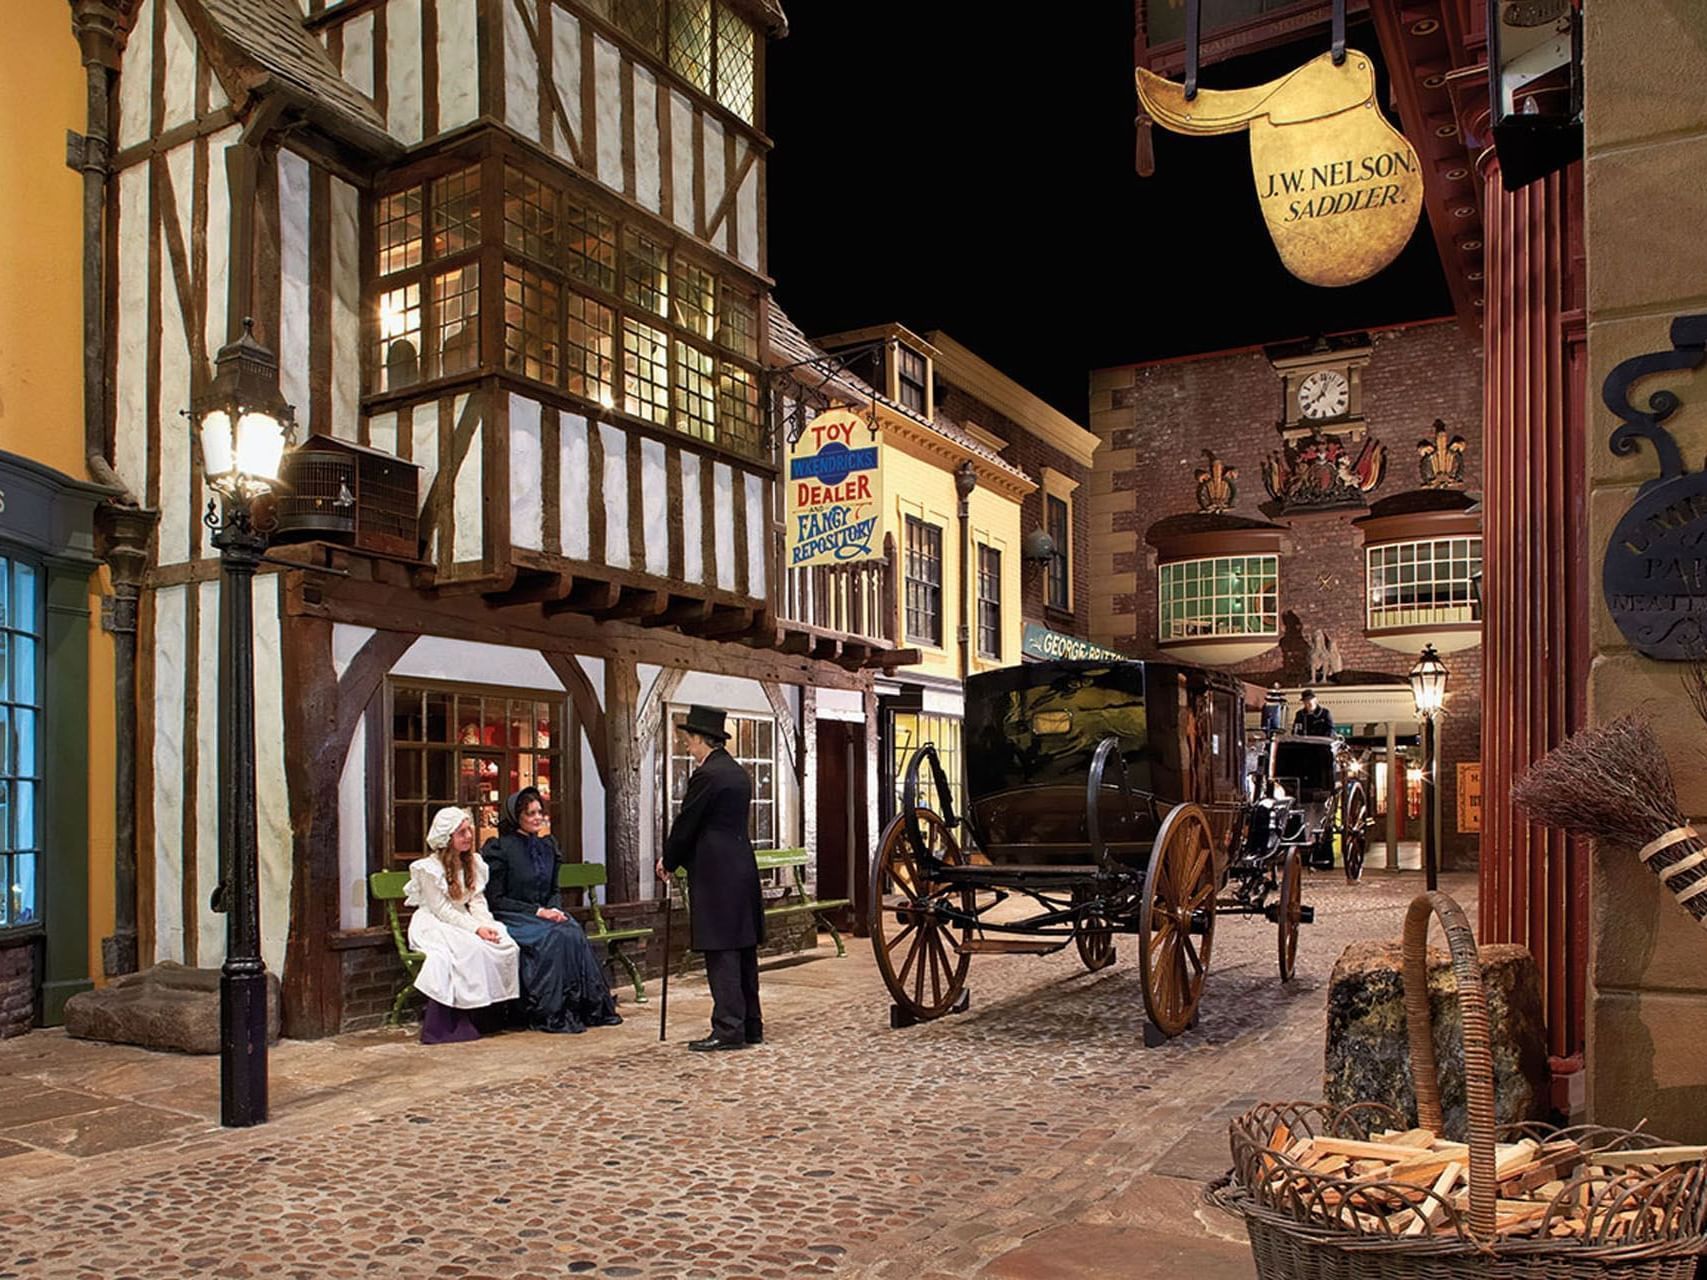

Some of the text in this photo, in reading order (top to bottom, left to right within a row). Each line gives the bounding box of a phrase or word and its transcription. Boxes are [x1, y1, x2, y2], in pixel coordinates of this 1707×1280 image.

[1312, 150, 1416, 190] NELSON.
[1284, 184, 1406, 222] SADDLER.
[811, 420, 857, 450] TOY
[798, 474, 873, 507] DEALER
[792, 515, 879, 565] REPOSITORY
[798, 505, 852, 543] FANCY
[1044, 633, 1087, 661] GEORGE
